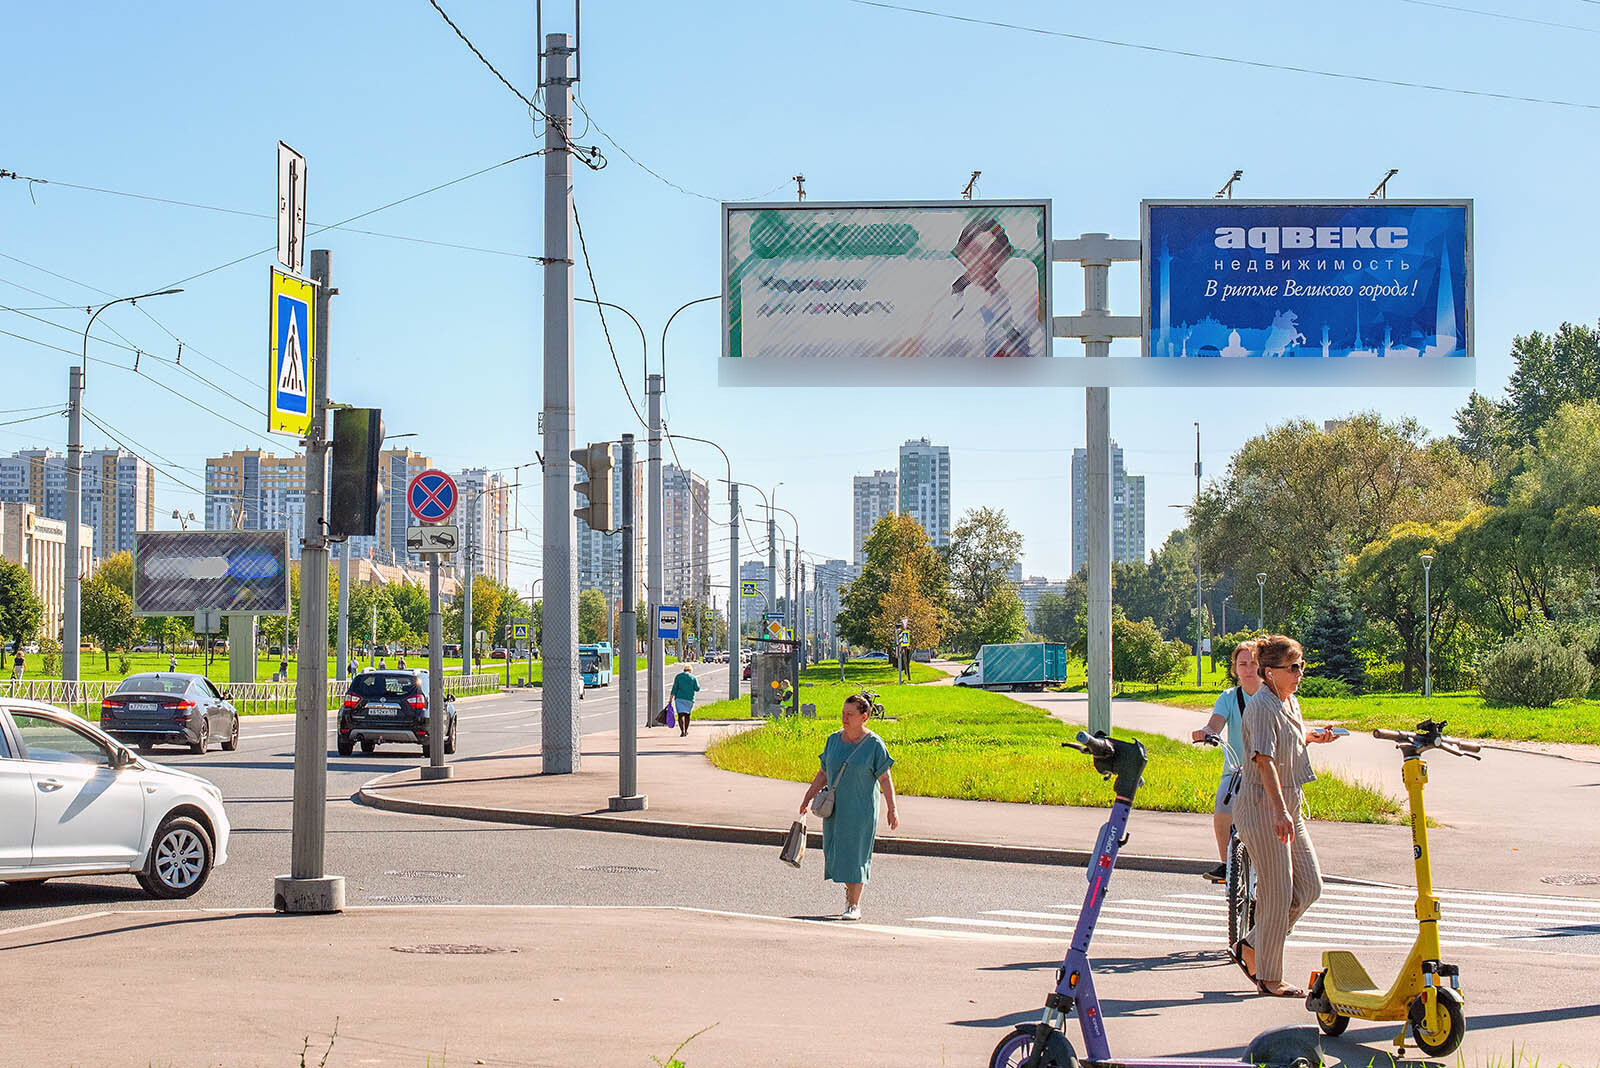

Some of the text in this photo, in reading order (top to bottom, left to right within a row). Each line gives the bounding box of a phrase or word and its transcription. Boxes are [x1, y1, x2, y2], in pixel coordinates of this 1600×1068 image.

[1214, 259, 1411, 273] недвижимость
[1204, 279, 1419, 302] В ритме Великого города!
